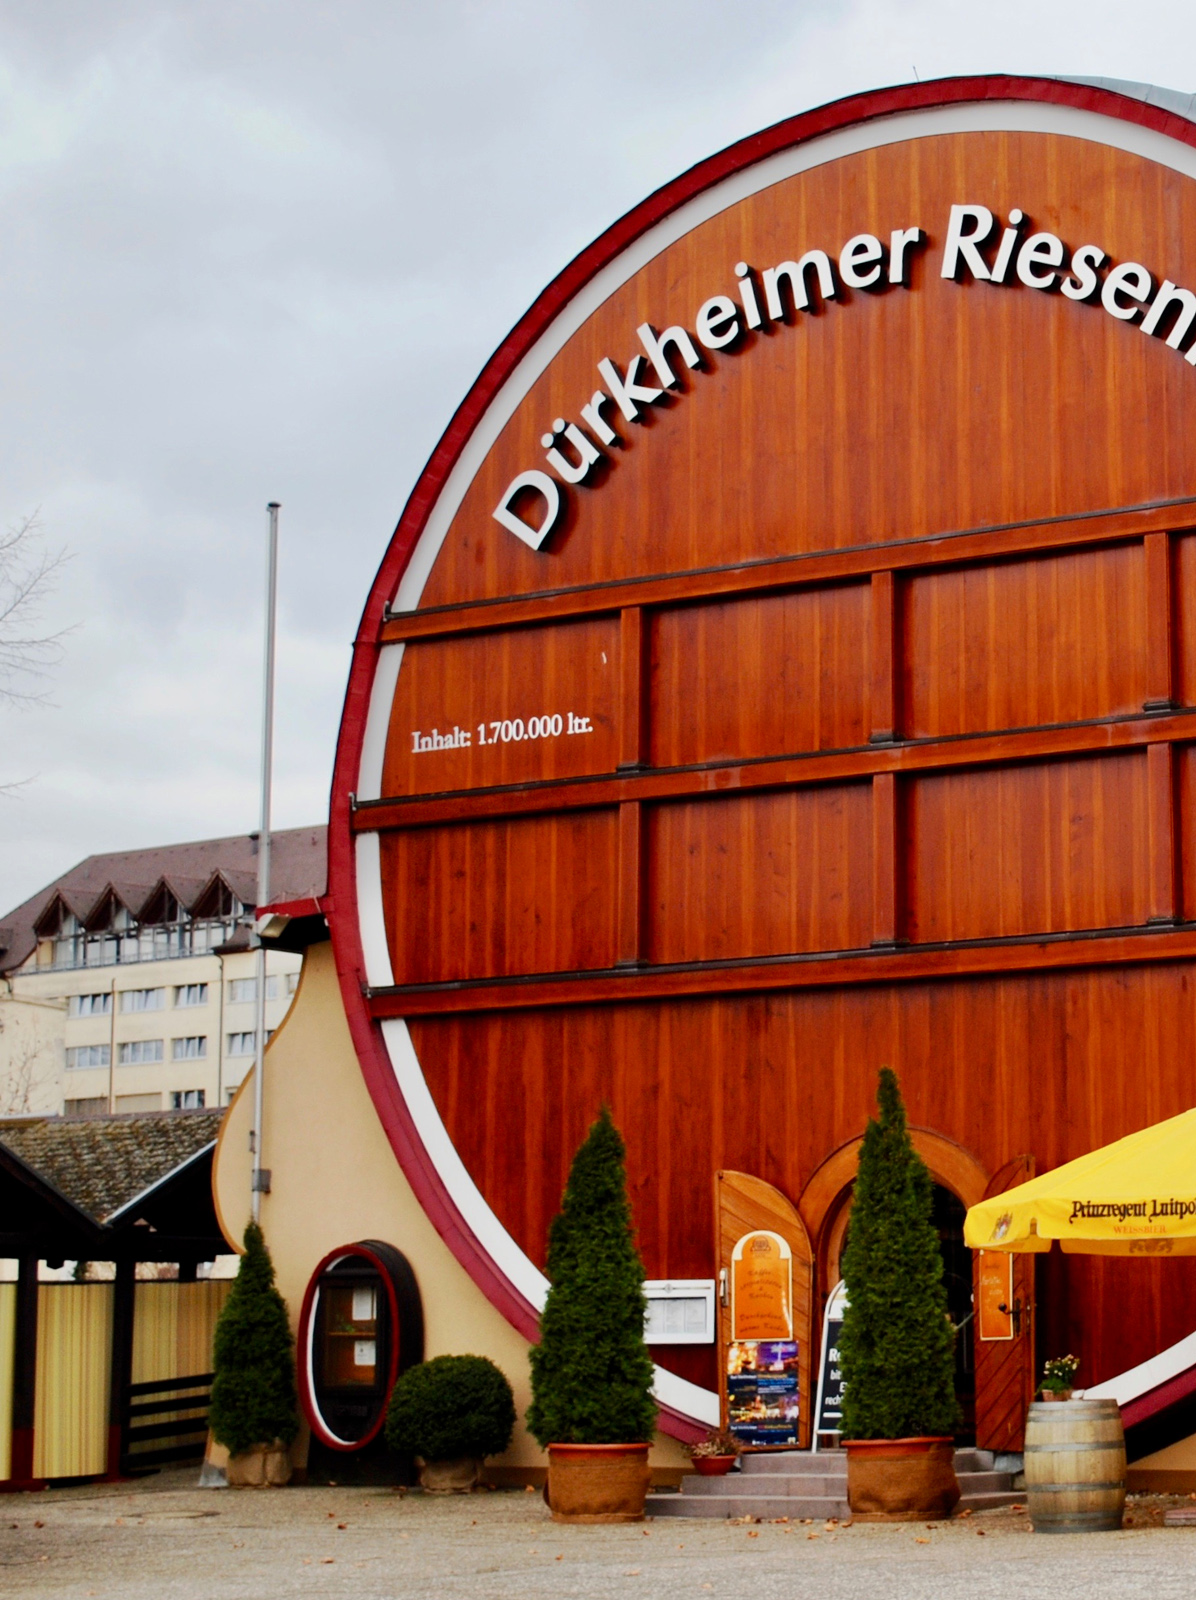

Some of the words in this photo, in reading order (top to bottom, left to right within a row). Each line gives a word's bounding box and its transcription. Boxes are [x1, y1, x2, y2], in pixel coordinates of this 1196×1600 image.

[492, 227, 920, 551] Dürkheimer
[411, 726, 472, 753] Inhalt:
[477, 714, 563, 745] 1.700.000
[566, 712, 593, 734] ltr.
[1069, 1200, 1147, 1224] Prinzregent
